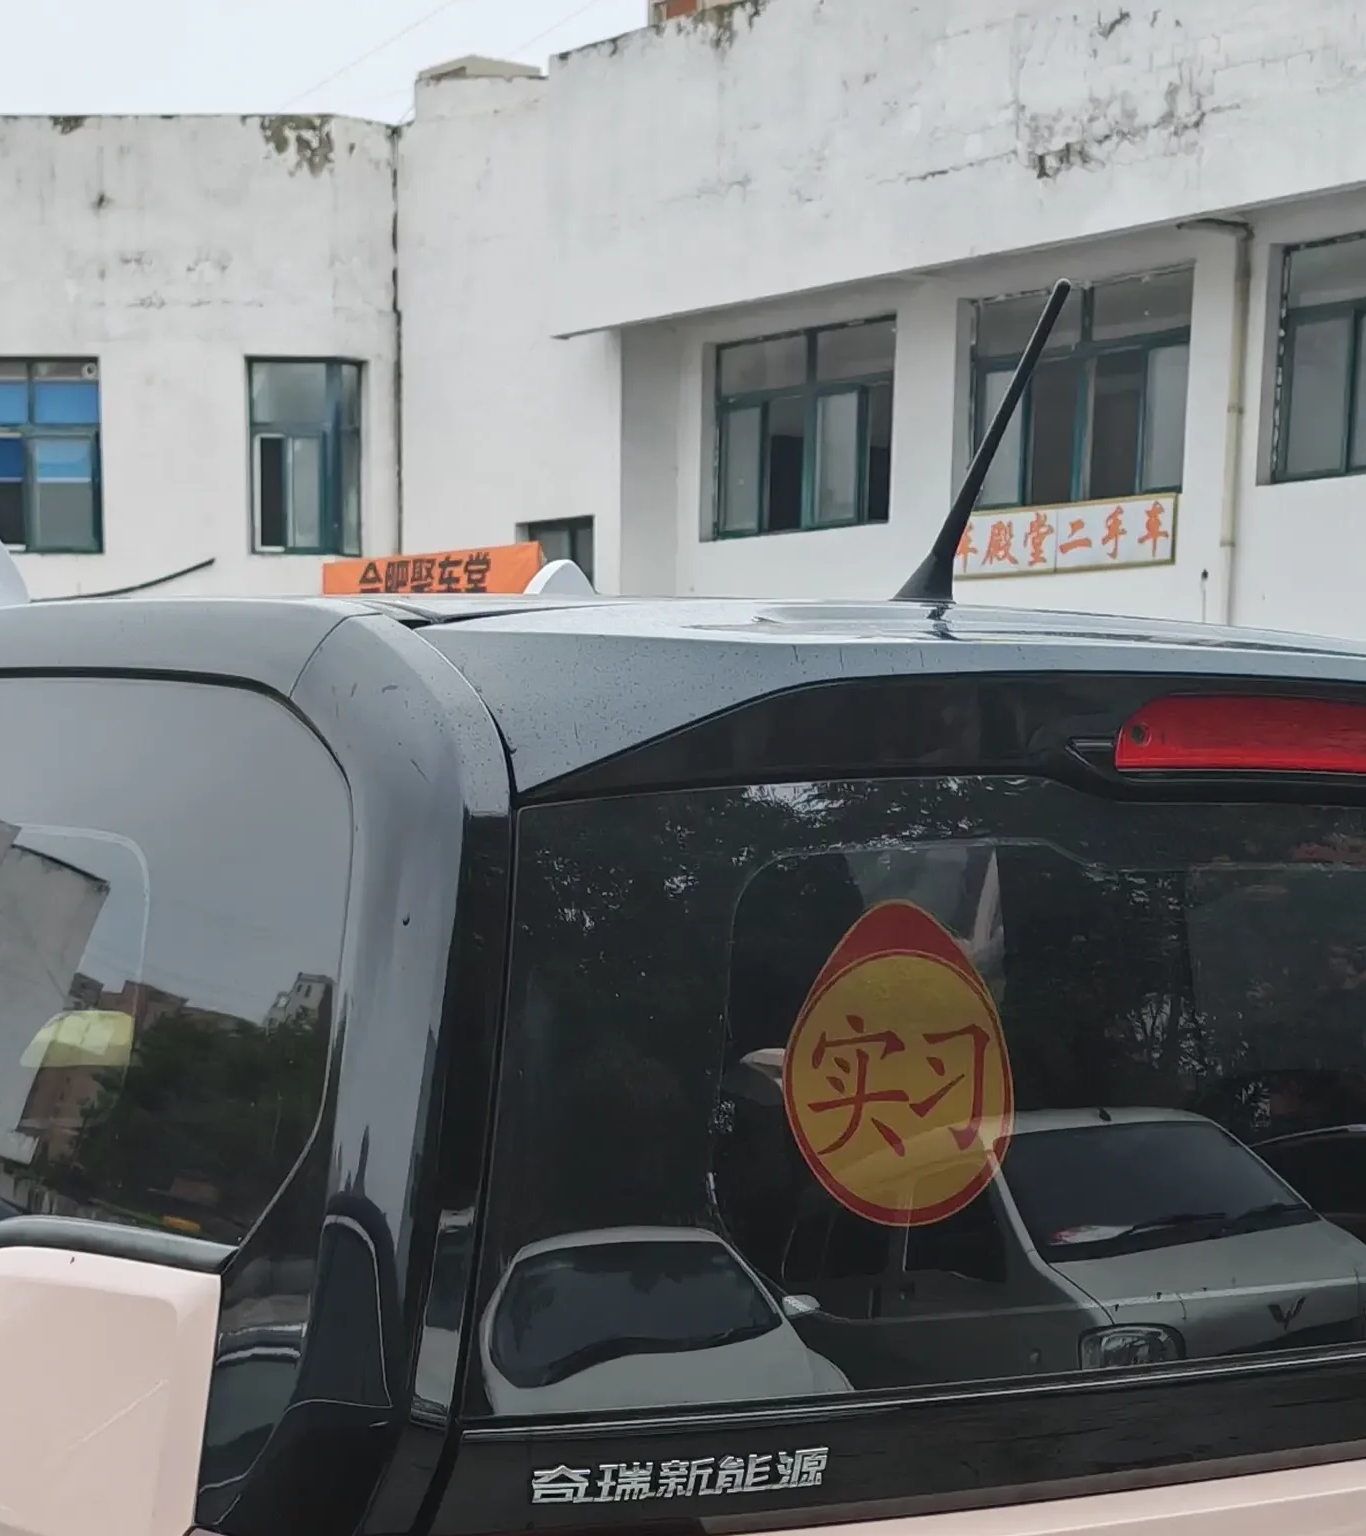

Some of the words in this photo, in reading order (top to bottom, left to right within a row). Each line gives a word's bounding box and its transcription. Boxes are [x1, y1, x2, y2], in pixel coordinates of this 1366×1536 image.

[807, 1014, 991, 1158] 实习
[530, 1446, 830, 1504] 奇瑞新能源
